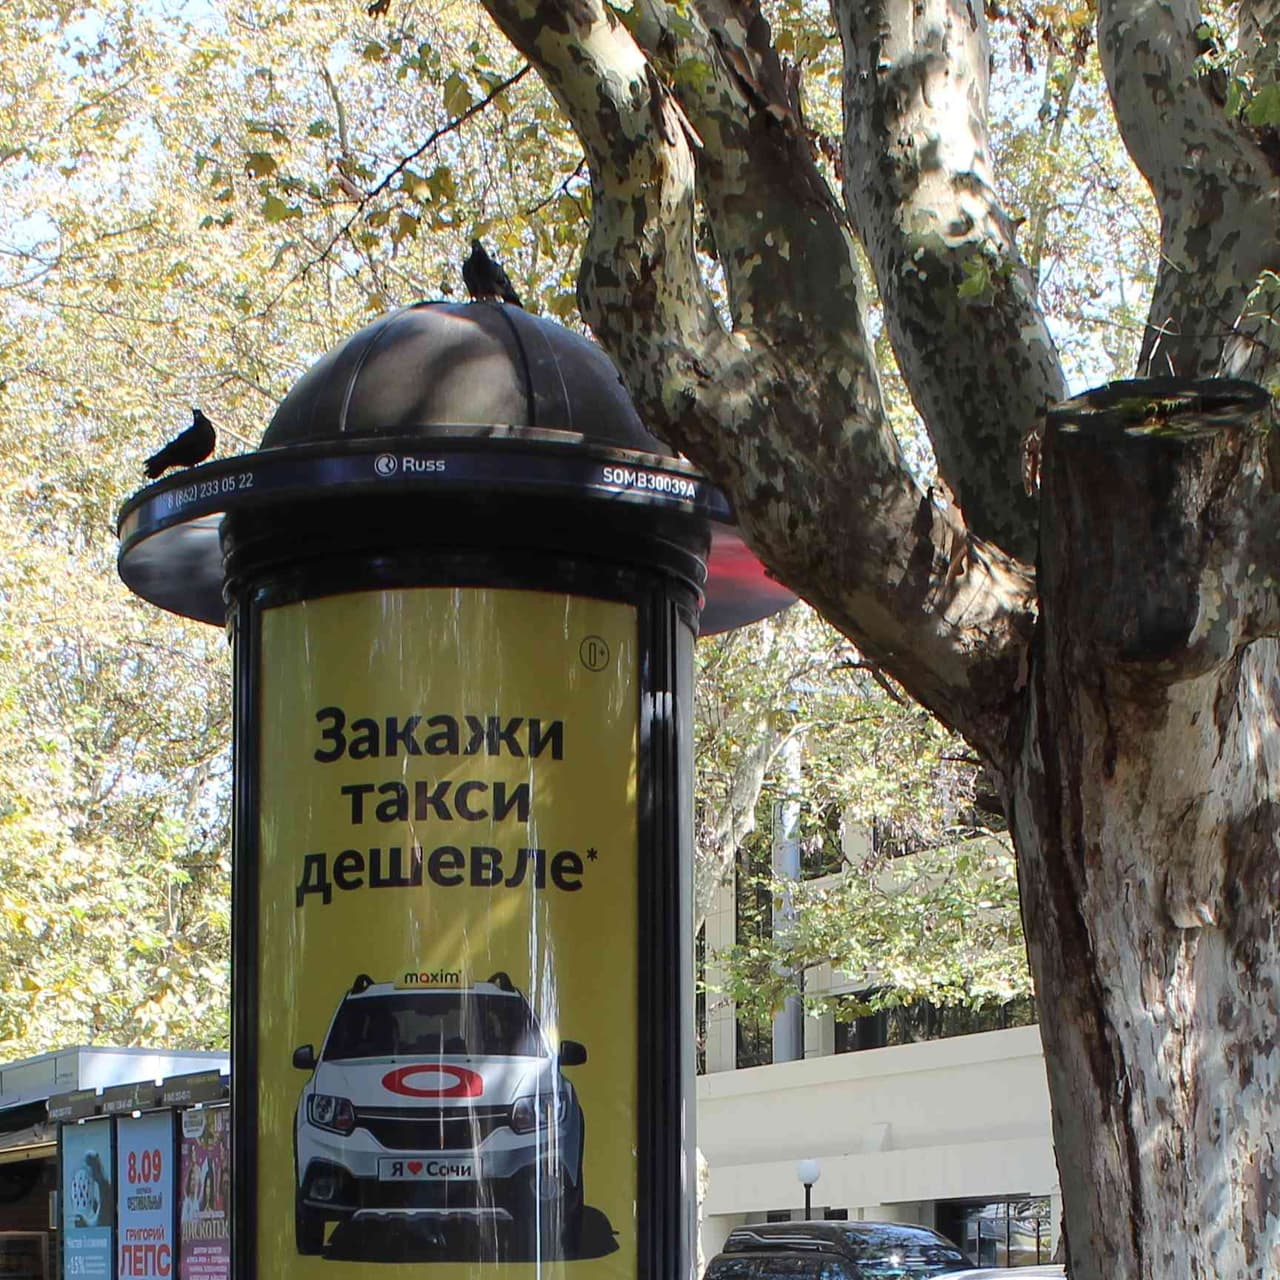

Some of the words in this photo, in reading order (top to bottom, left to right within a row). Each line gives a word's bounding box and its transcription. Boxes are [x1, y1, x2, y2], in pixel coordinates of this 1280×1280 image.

[403, 457, 445, 472] Russ
[200, 480, 218, 498] 233
[222, 476, 235, 492] 05
[239, 472, 253, 488] 22
[603, 467, 696, 498] SOMB30039A
[314, 706, 564, 763] Закажи
[341, 779, 530, 825] такси
[128, 1149, 162, 1184] 8.09
[391, 1162, 403, 1177] Я
[427, 1161, 471, 1177] Сочи
[126, 1224, 165, 1241] ГРИГОРИЙ
[120, 1243, 171, 1276] ЛЕПС
